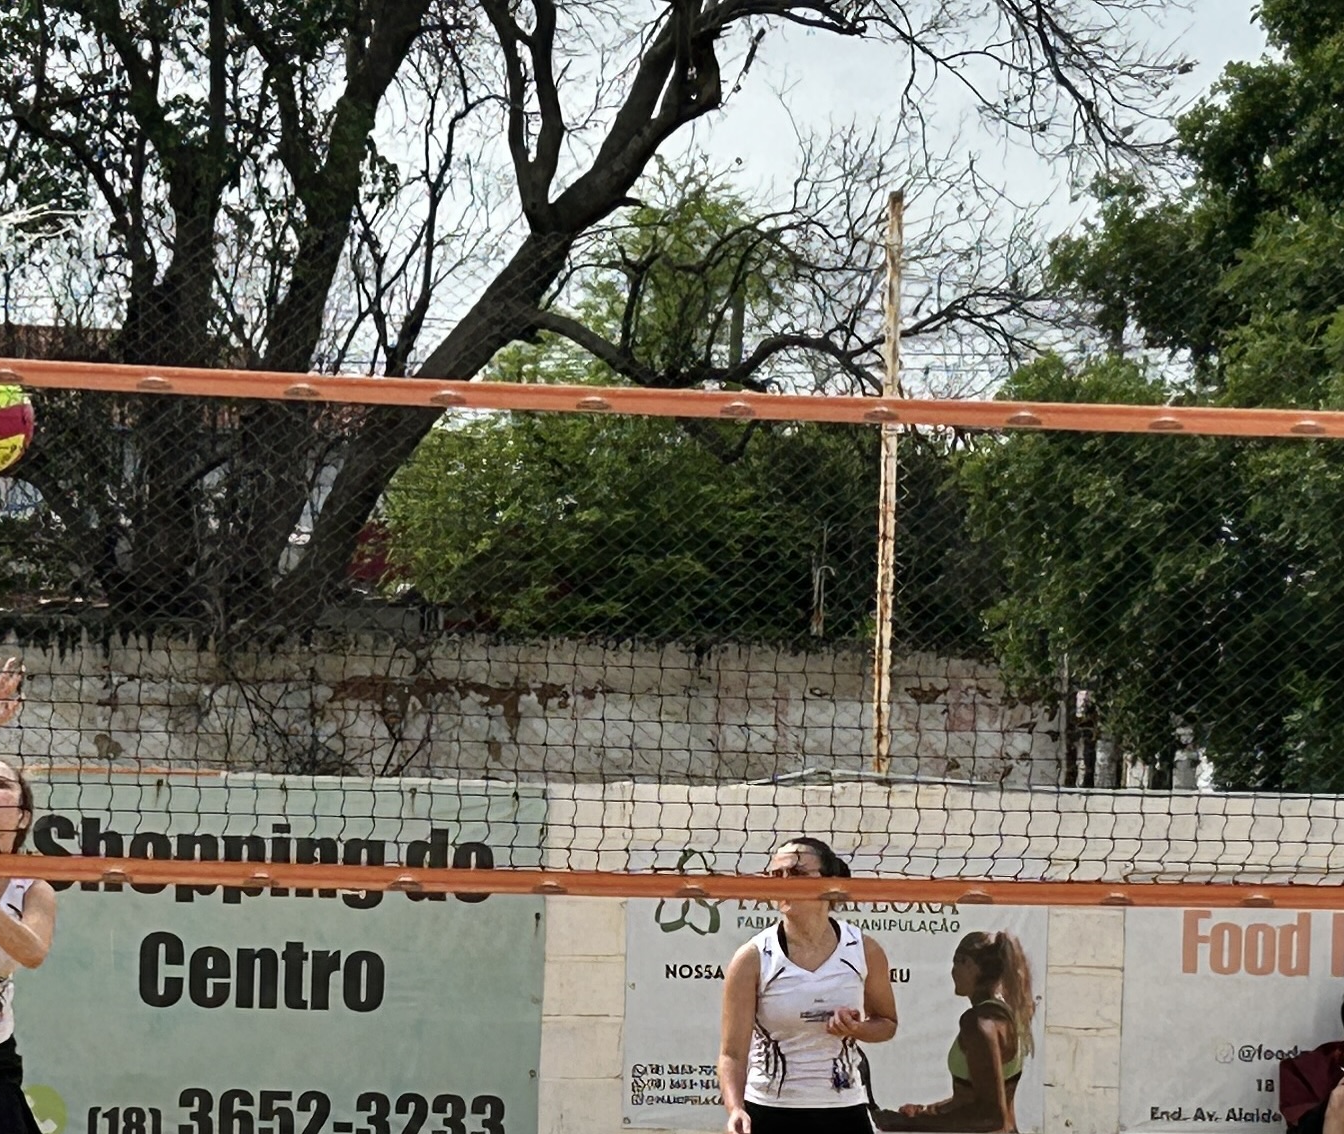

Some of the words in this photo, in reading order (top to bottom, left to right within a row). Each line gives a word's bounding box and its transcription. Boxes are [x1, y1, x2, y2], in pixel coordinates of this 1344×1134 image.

[33, 813, 386, 910] Shopping
[406, 828, 494, 904] do
[139, 931, 386, 1013] Centro
[665, 964, 725, 980] NOSSA
[1182, 909, 1312, 977] Food
[1256, 1078, 1275, 1093] 18
